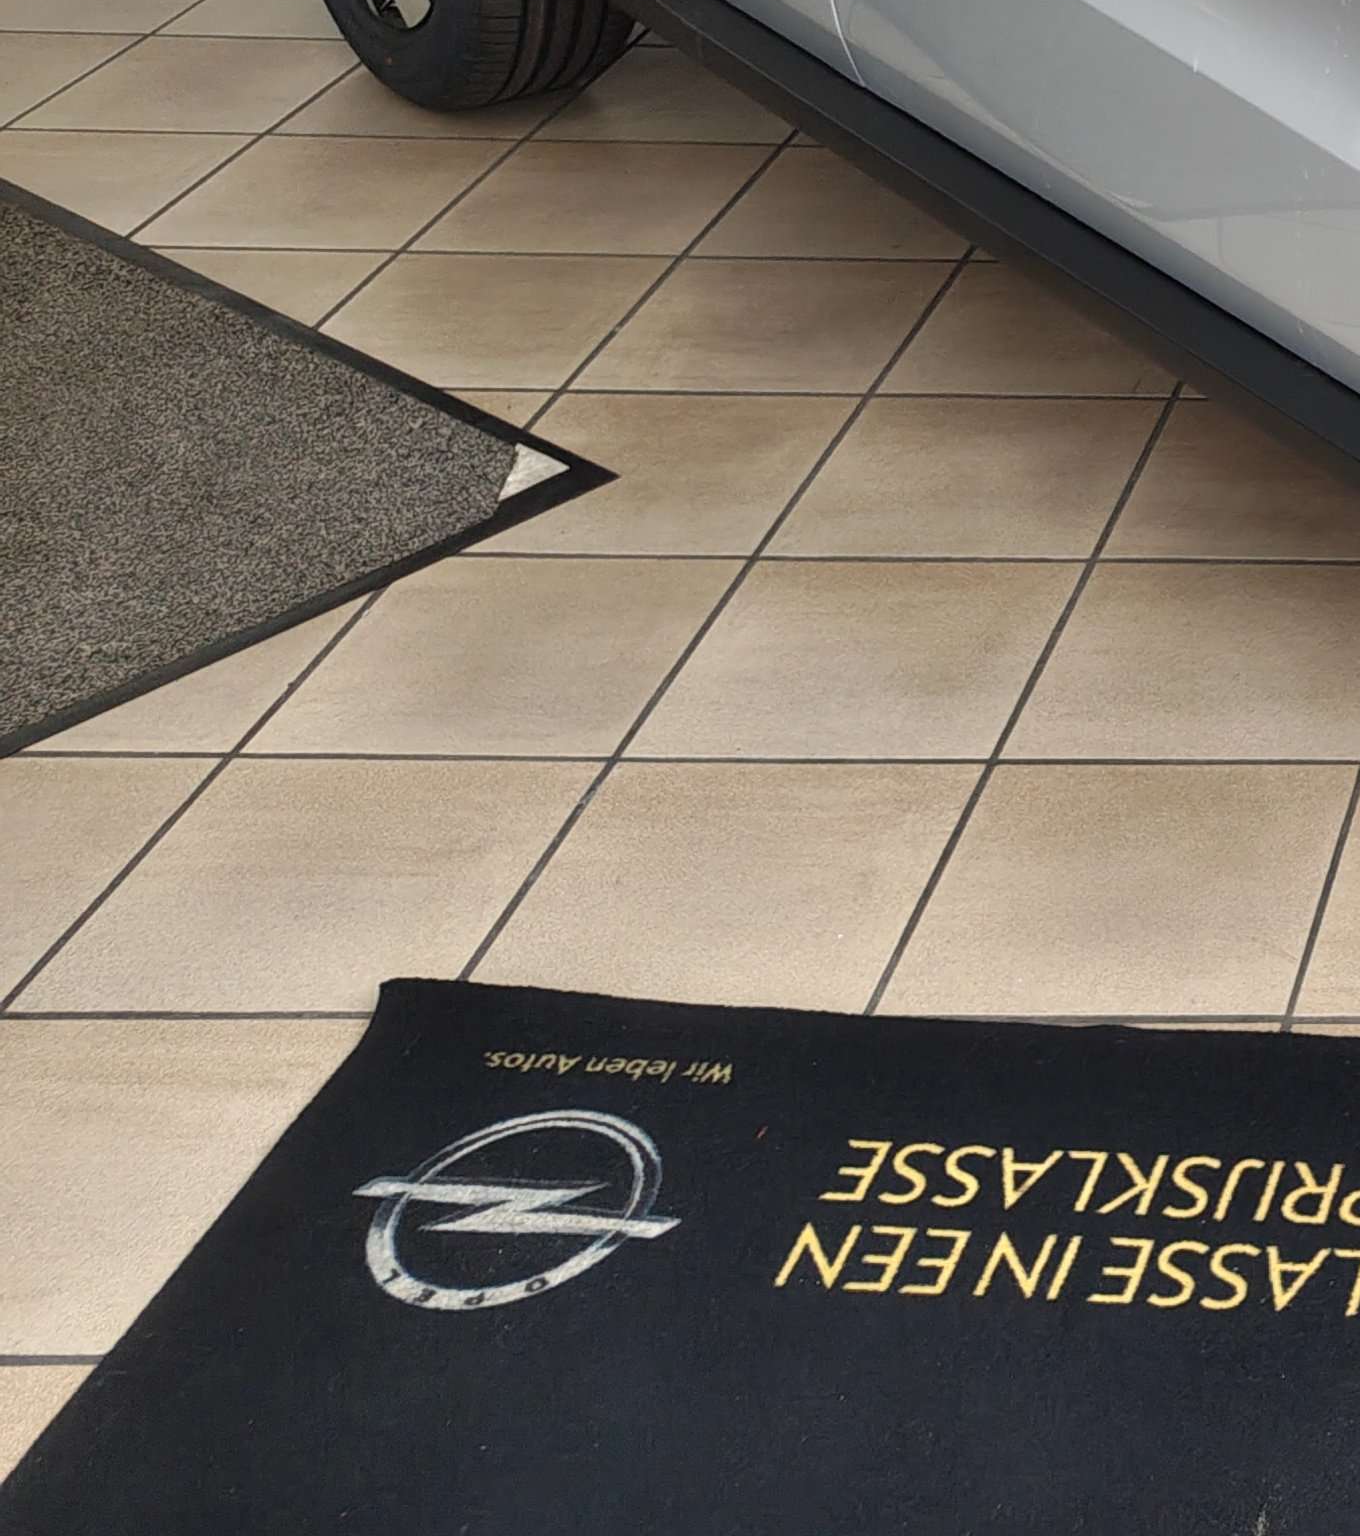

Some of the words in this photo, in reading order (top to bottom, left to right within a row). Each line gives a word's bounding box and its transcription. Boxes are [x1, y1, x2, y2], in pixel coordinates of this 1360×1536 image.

[482, 1050, 582, 1075] Autos.
[585, 1058, 677, 1084] leben
[680, 1059, 733, 1085] Wir
[772, 1222, 972, 1296] EEN
[972, 1231, 1083, 1301] IN
[381, 1267, 550, 1307] OPEL
